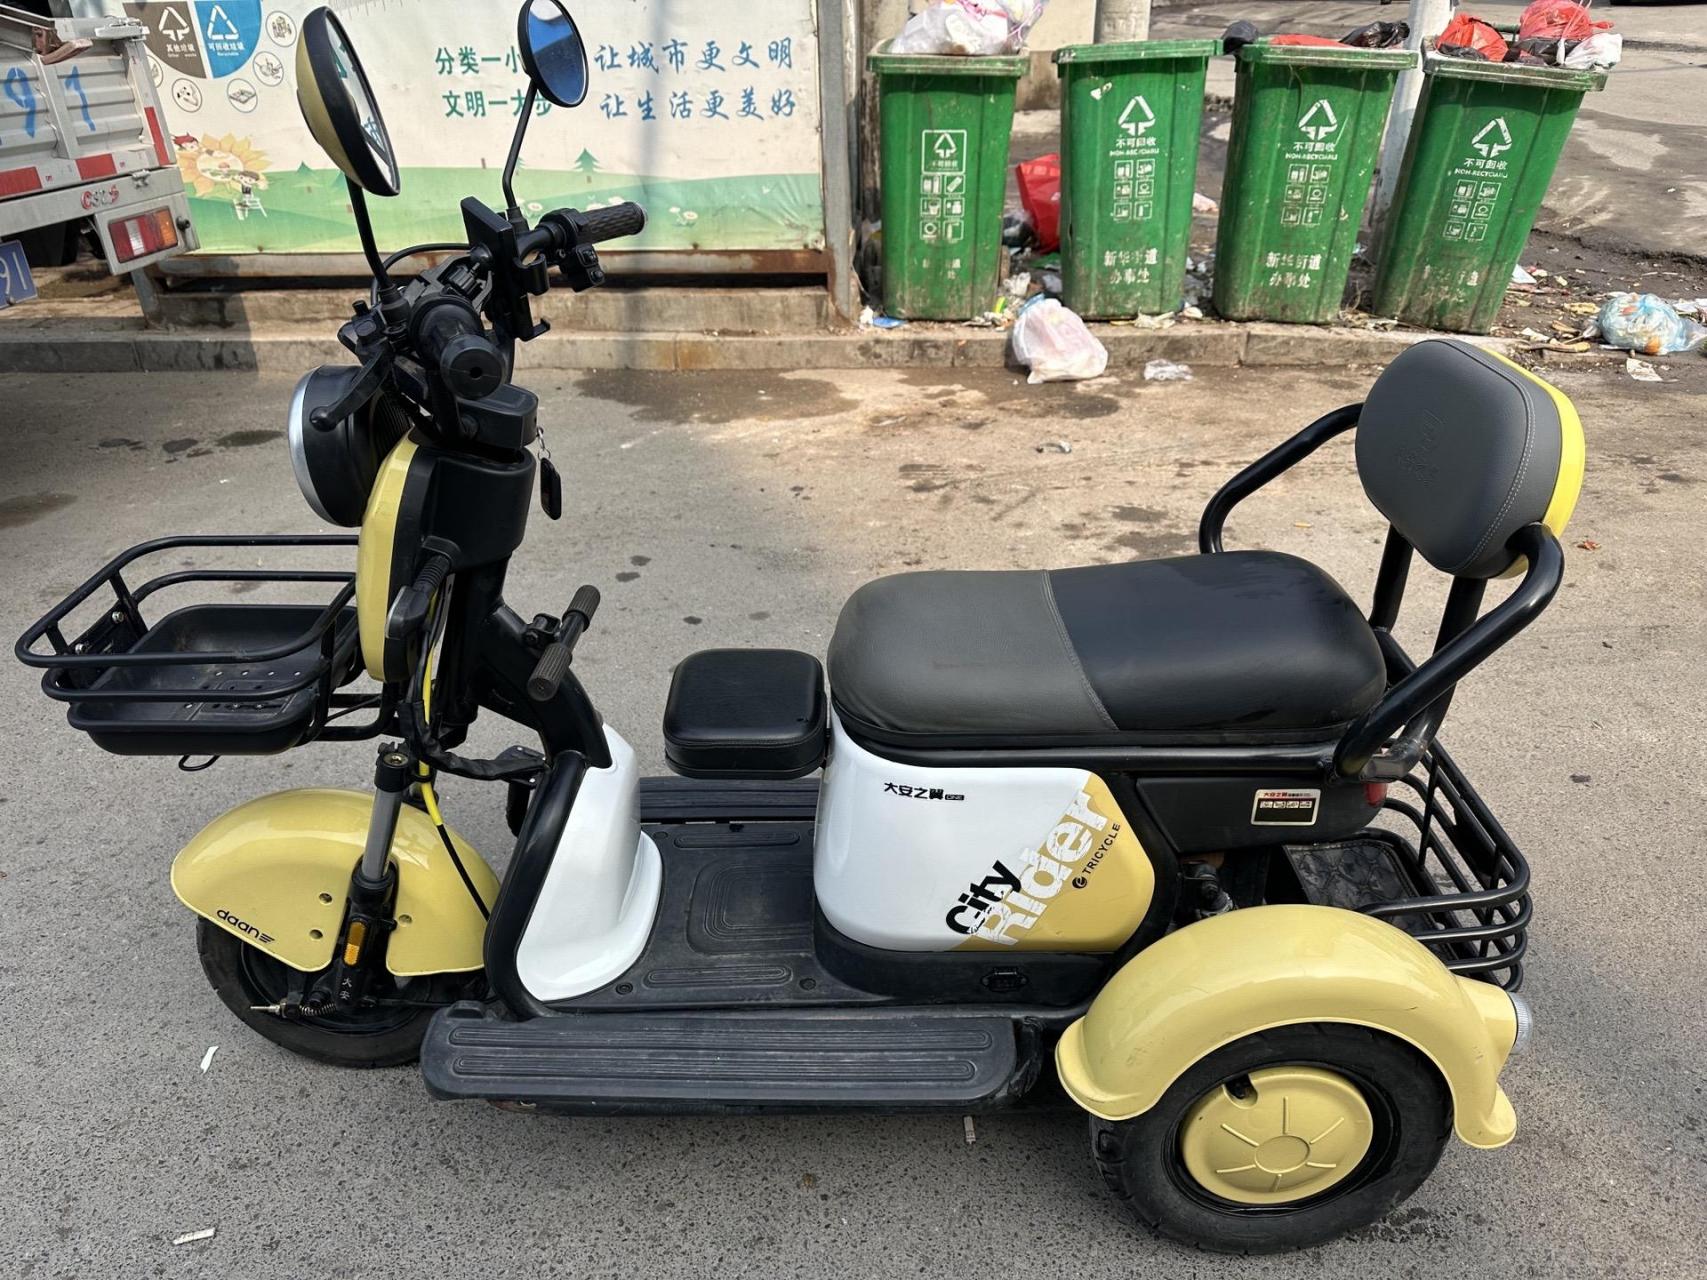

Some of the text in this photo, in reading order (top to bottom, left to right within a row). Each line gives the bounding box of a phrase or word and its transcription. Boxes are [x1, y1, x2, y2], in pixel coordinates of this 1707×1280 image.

[594, 37, 792, 74] 让城市更文明
[600, 86, 795, 120] 让生活更美好
[1115, 136, 1157, 148] 不可回收
[1293, 141, 1336, 152] 不可回收
[1463, 157, 1508, 170] 不可回收
[1082, 823, 1121, 874] TRICYCLE
[973, 790, 1107, 946] Rider
[946, 860, 1021, 934] City
